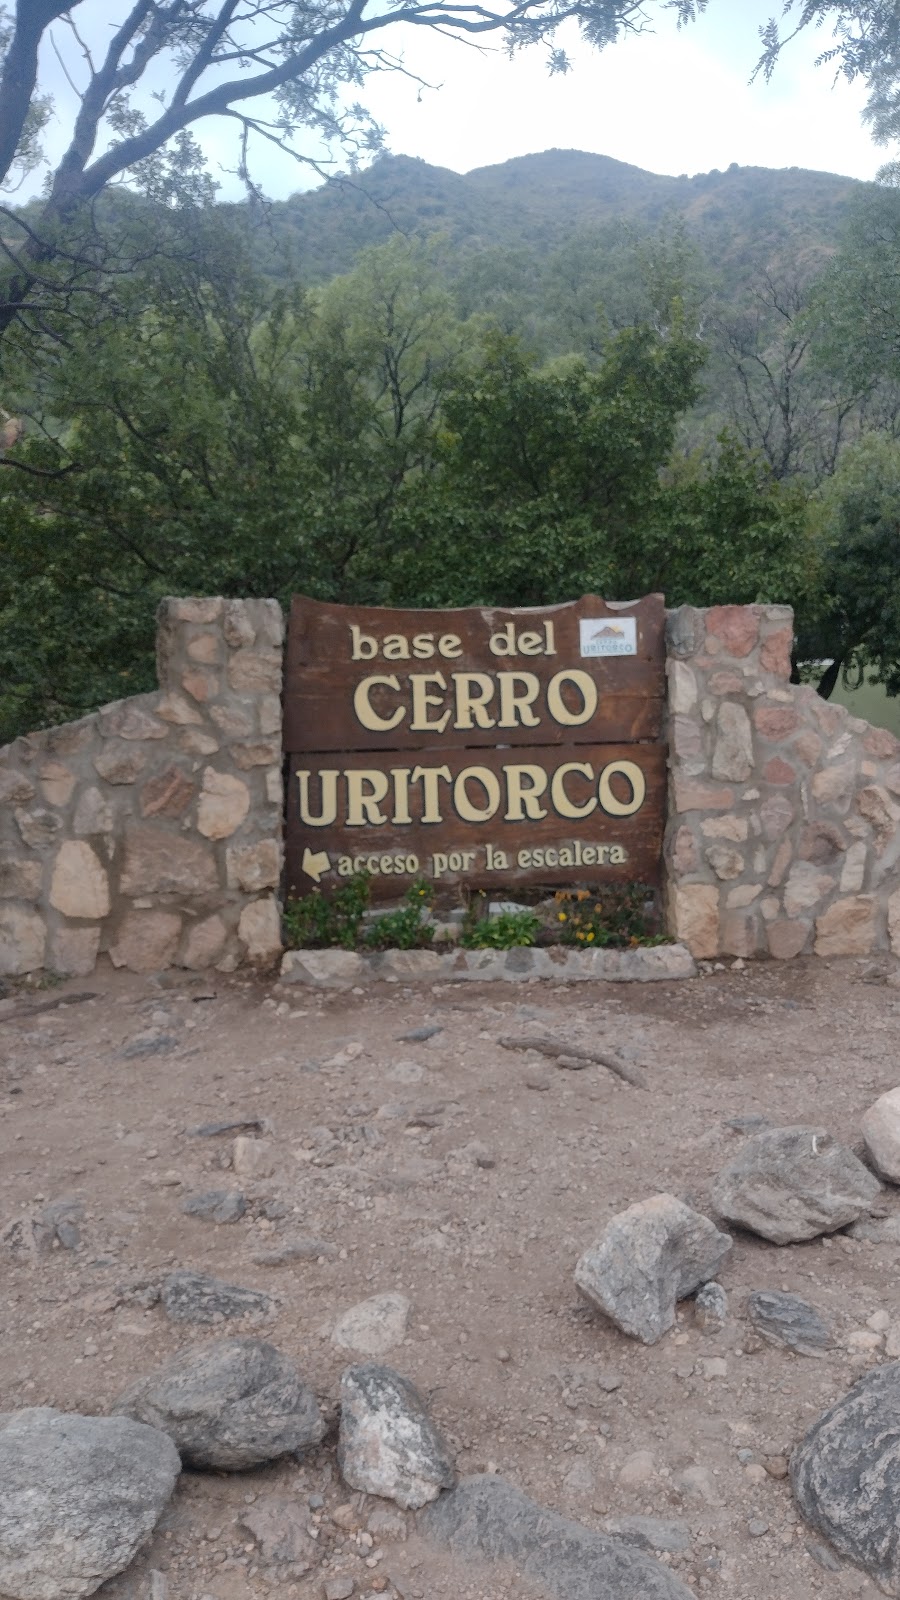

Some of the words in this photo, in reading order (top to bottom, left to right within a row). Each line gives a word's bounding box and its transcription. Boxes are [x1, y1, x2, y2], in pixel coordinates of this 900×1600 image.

[349, 624, 463, 660] base
[488, 620, 558, 656] del
[353, 669, 598, 733] CERRO
[295, 760, 646, 827] URITORCO
[337, 853, 420, 877] acceso
[432, 851, 476, 878] por
[485, 843, 510, 870] la
[517, 839, 628, 868] escalera
